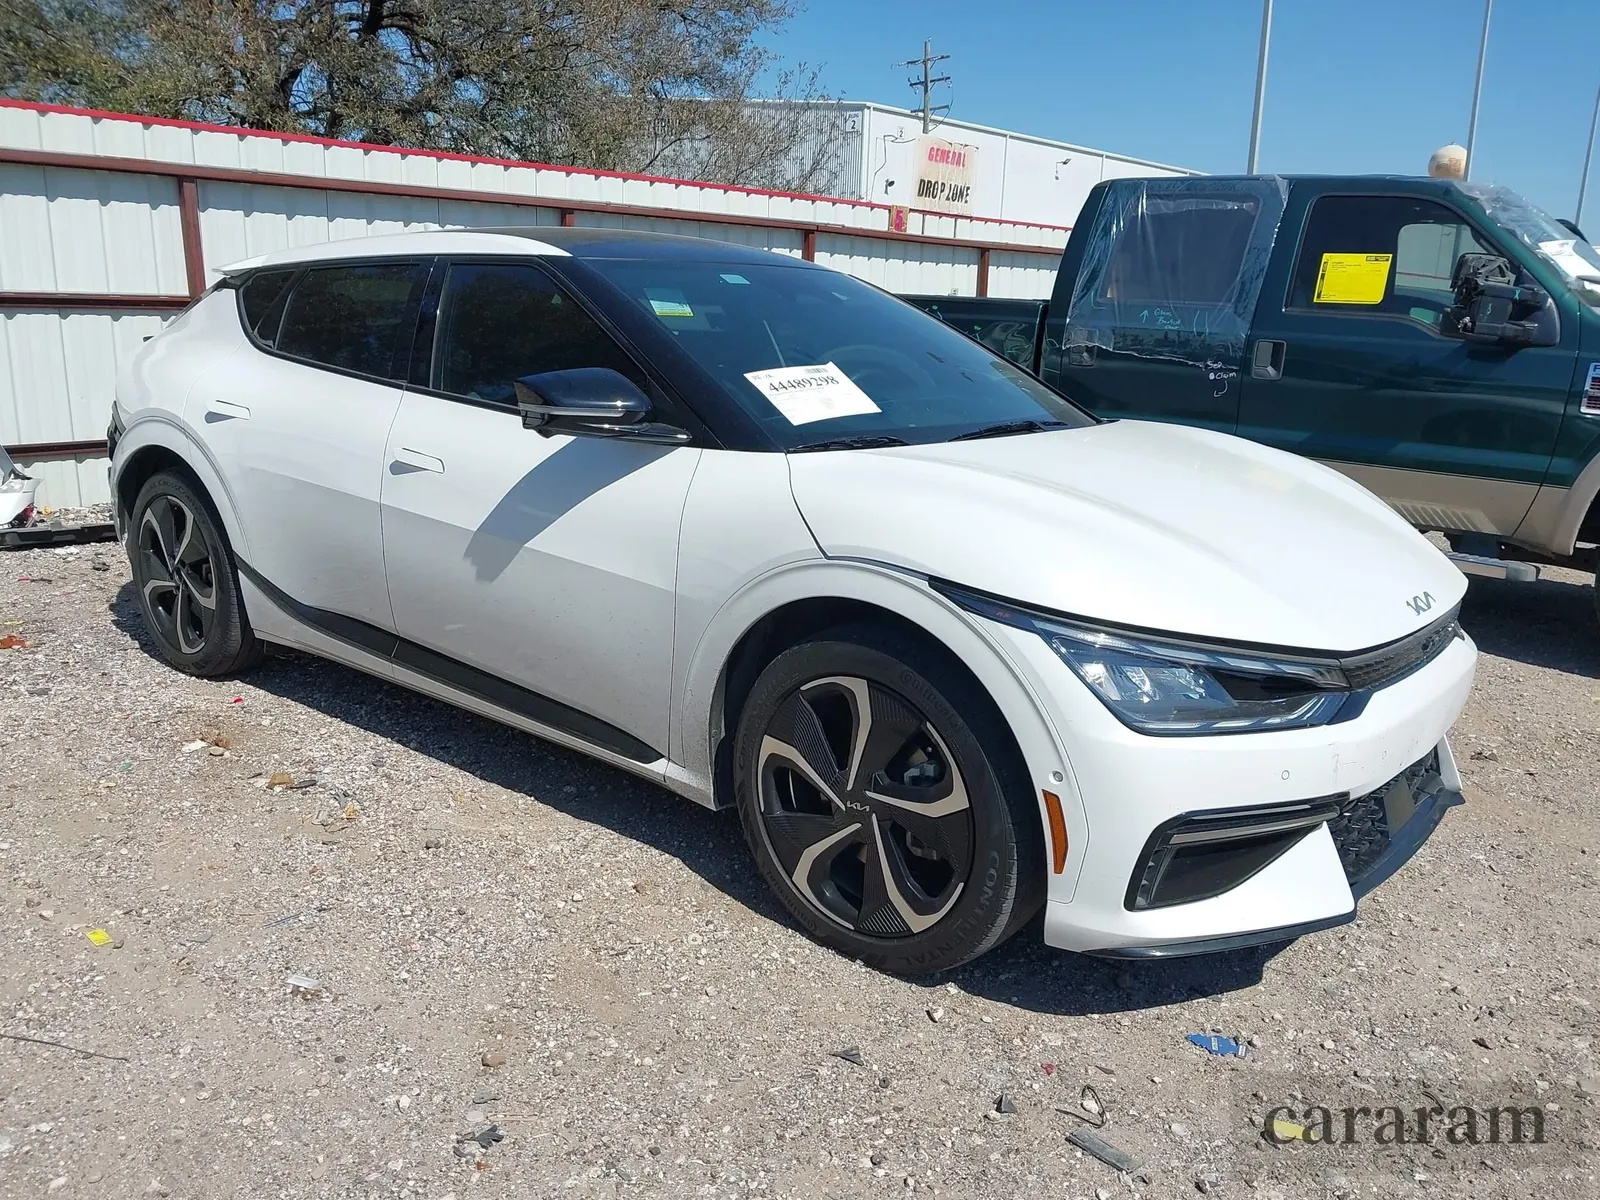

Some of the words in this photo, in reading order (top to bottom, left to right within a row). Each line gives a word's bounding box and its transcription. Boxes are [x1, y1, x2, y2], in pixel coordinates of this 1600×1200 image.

[851, 119, 856, 130] 2
[928, 146, 966, 168] GENERAL
[917, 178, 946, 200] DROP
[945, 183, 970, 204] ZONE
[769, 375, 840, 392] 44489298
